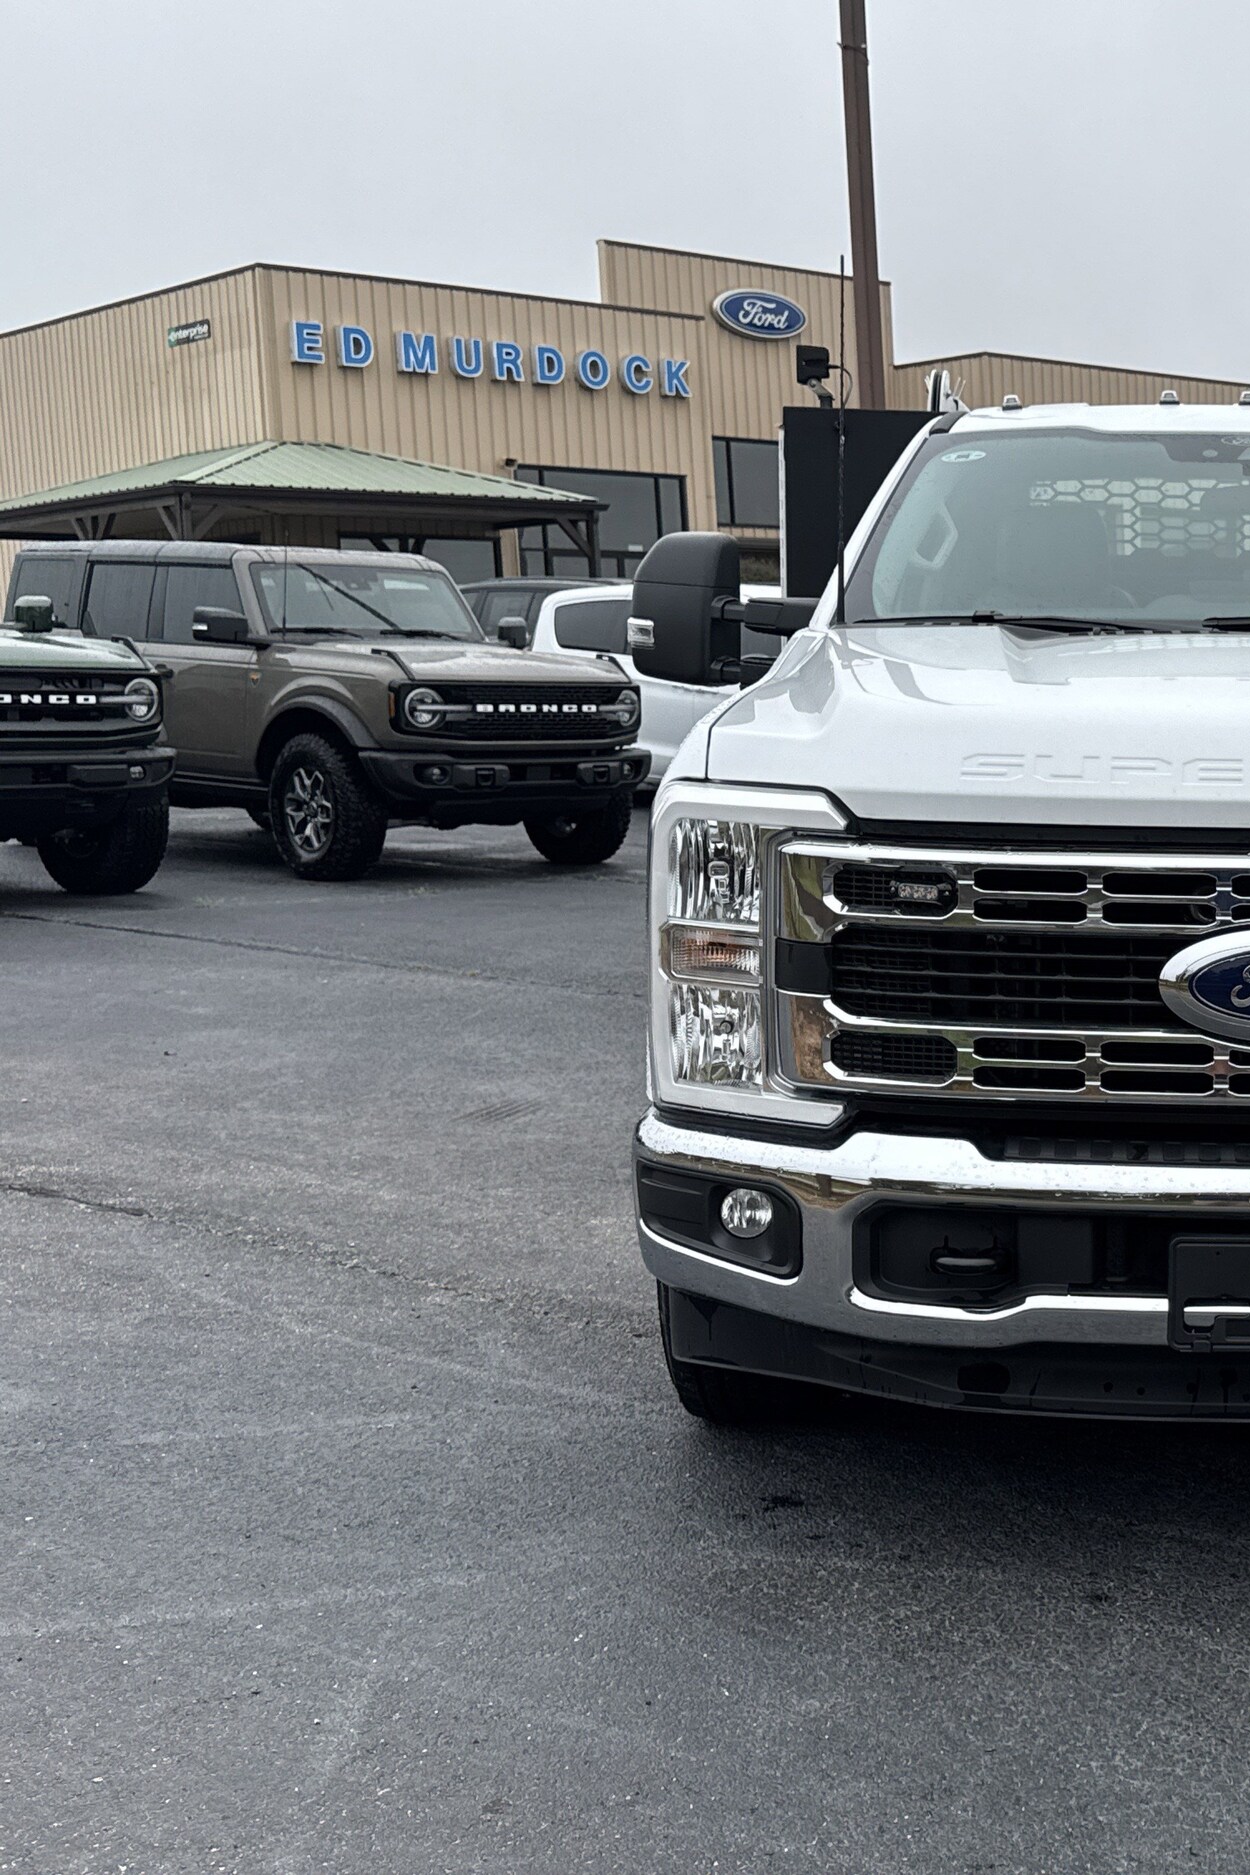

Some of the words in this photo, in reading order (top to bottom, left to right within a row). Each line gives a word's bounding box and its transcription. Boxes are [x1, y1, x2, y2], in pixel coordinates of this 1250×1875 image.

[738, 298, 789, 329] Ford
[290, 320, 374, 368] ED
[396, 330, 693, 399] MURDOCK
[476, 703, 597, 713] BRONCO
